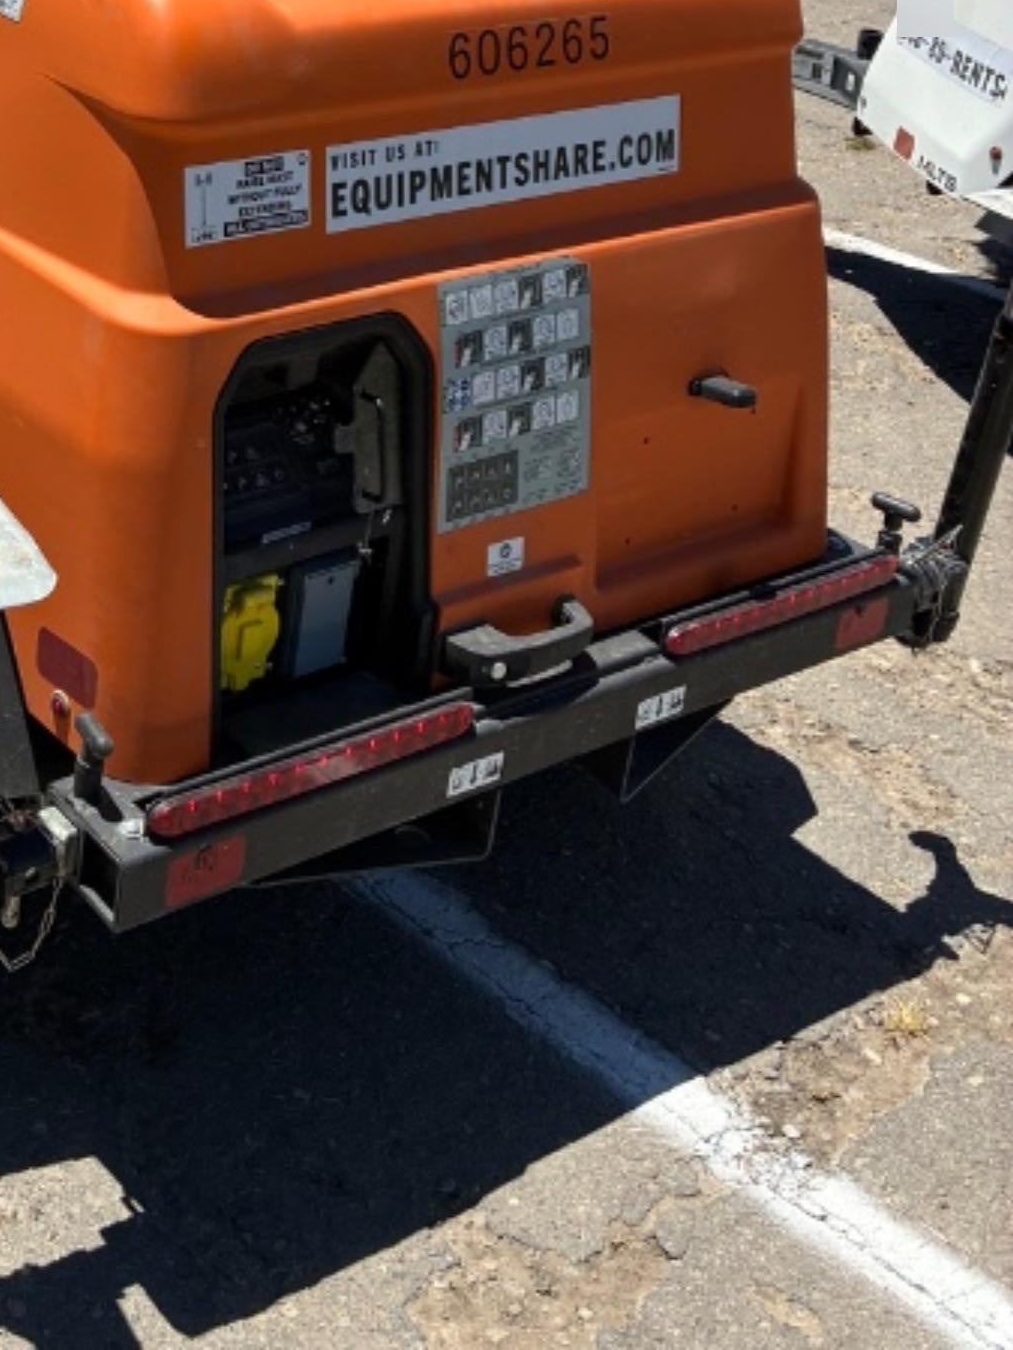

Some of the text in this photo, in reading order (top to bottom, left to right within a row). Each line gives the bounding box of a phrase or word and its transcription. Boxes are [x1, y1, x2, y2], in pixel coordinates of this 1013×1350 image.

[448, 15, 610, 79] 606265
[329, 148, 377, 171] VISIT
[385, 143, 406, 163] US
[331, 128, 675, 218] EQUIPMENTSHARE.COM
